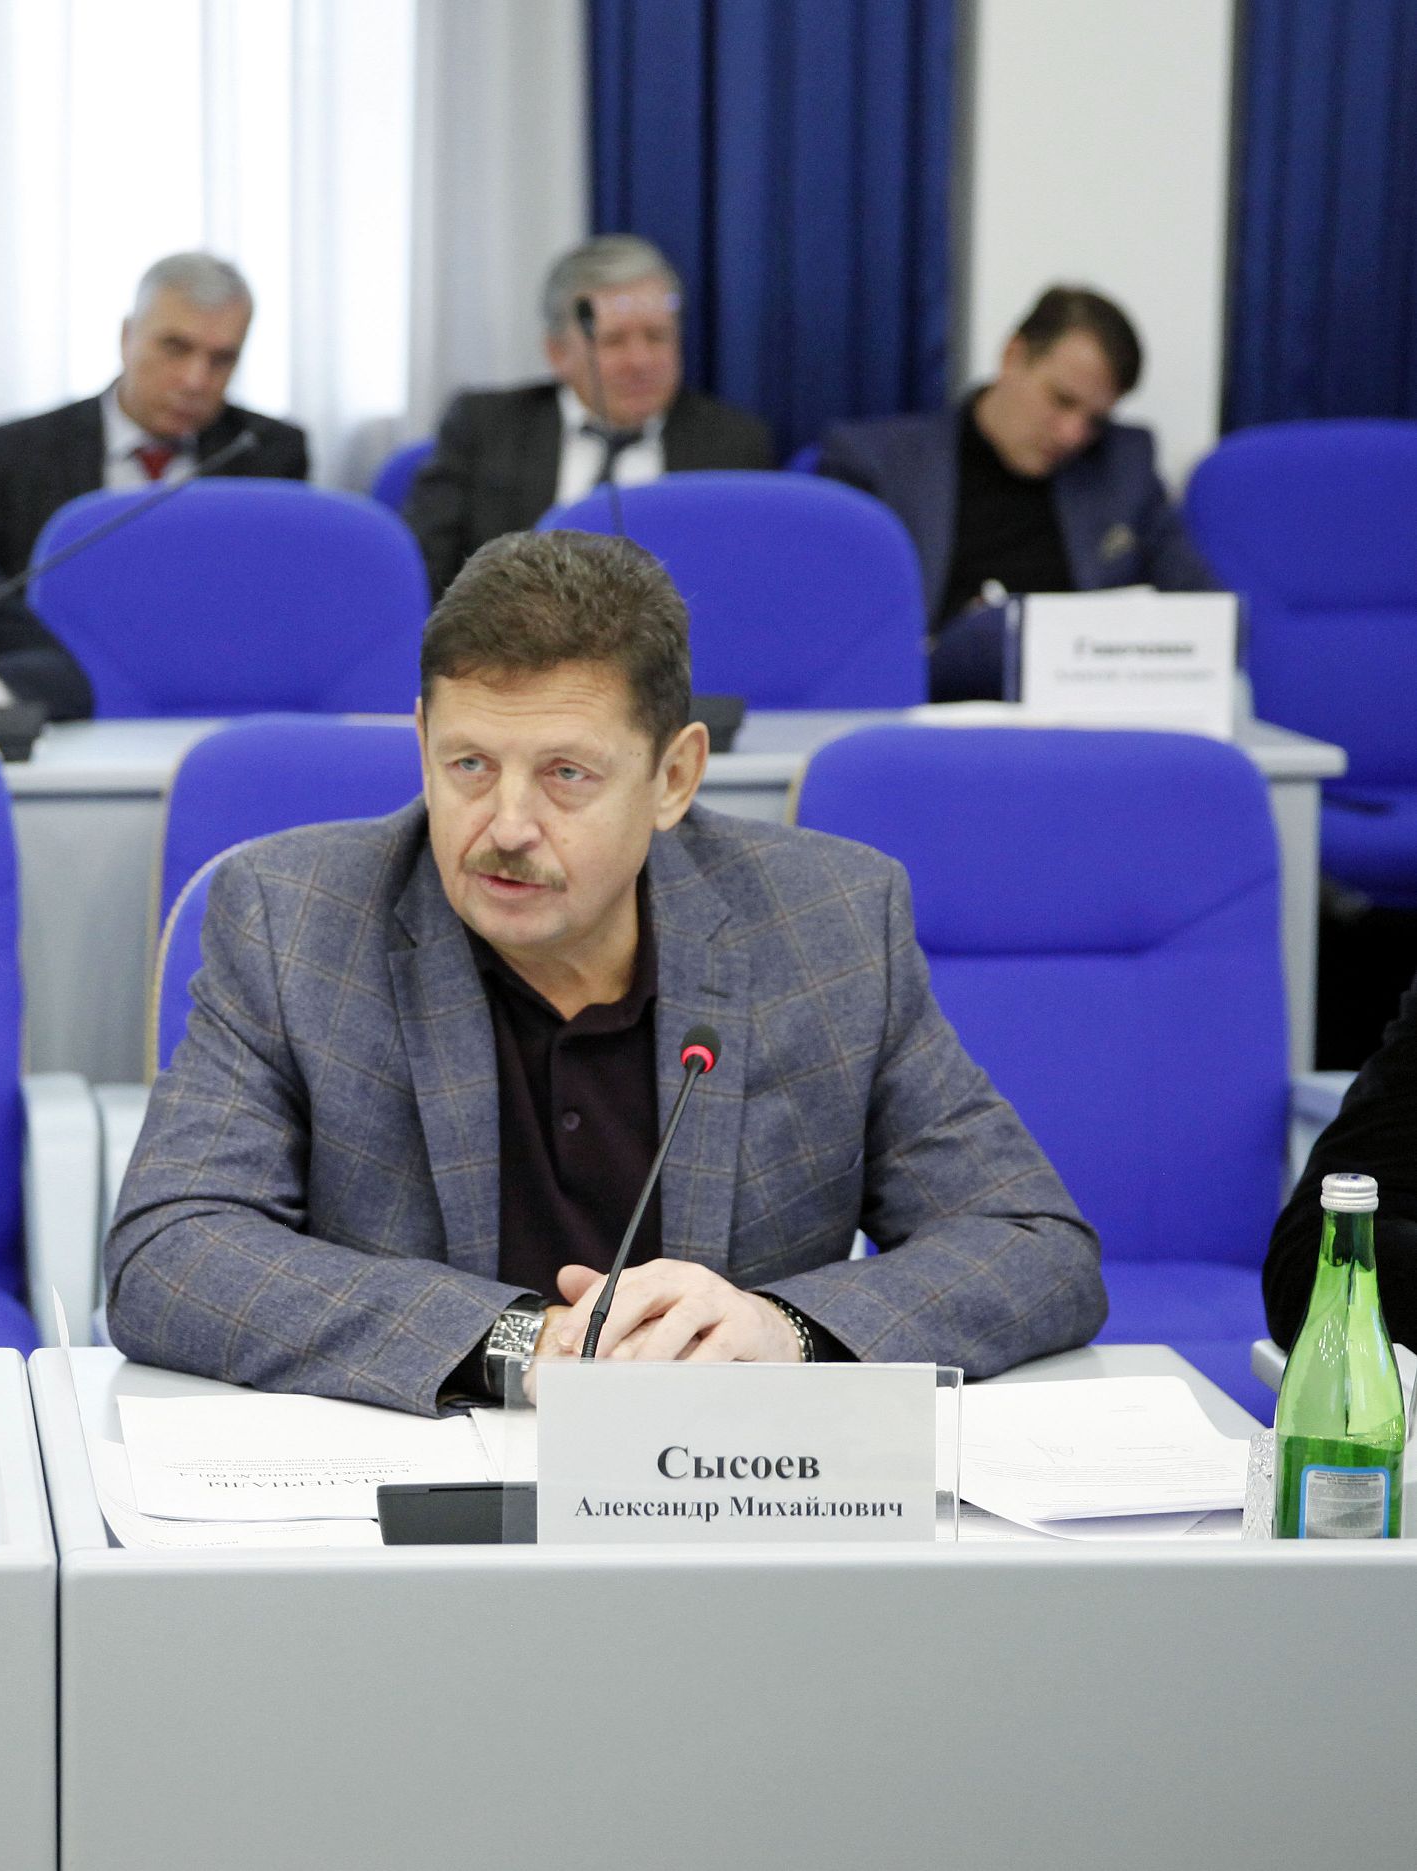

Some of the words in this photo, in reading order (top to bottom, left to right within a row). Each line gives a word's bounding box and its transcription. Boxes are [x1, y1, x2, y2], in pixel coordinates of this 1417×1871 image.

[656, 1445, 821, 1480] Сысоев
[574, 1496, 720, 1523] Александр
[729, 1495, 904, 1518] Михайлович
